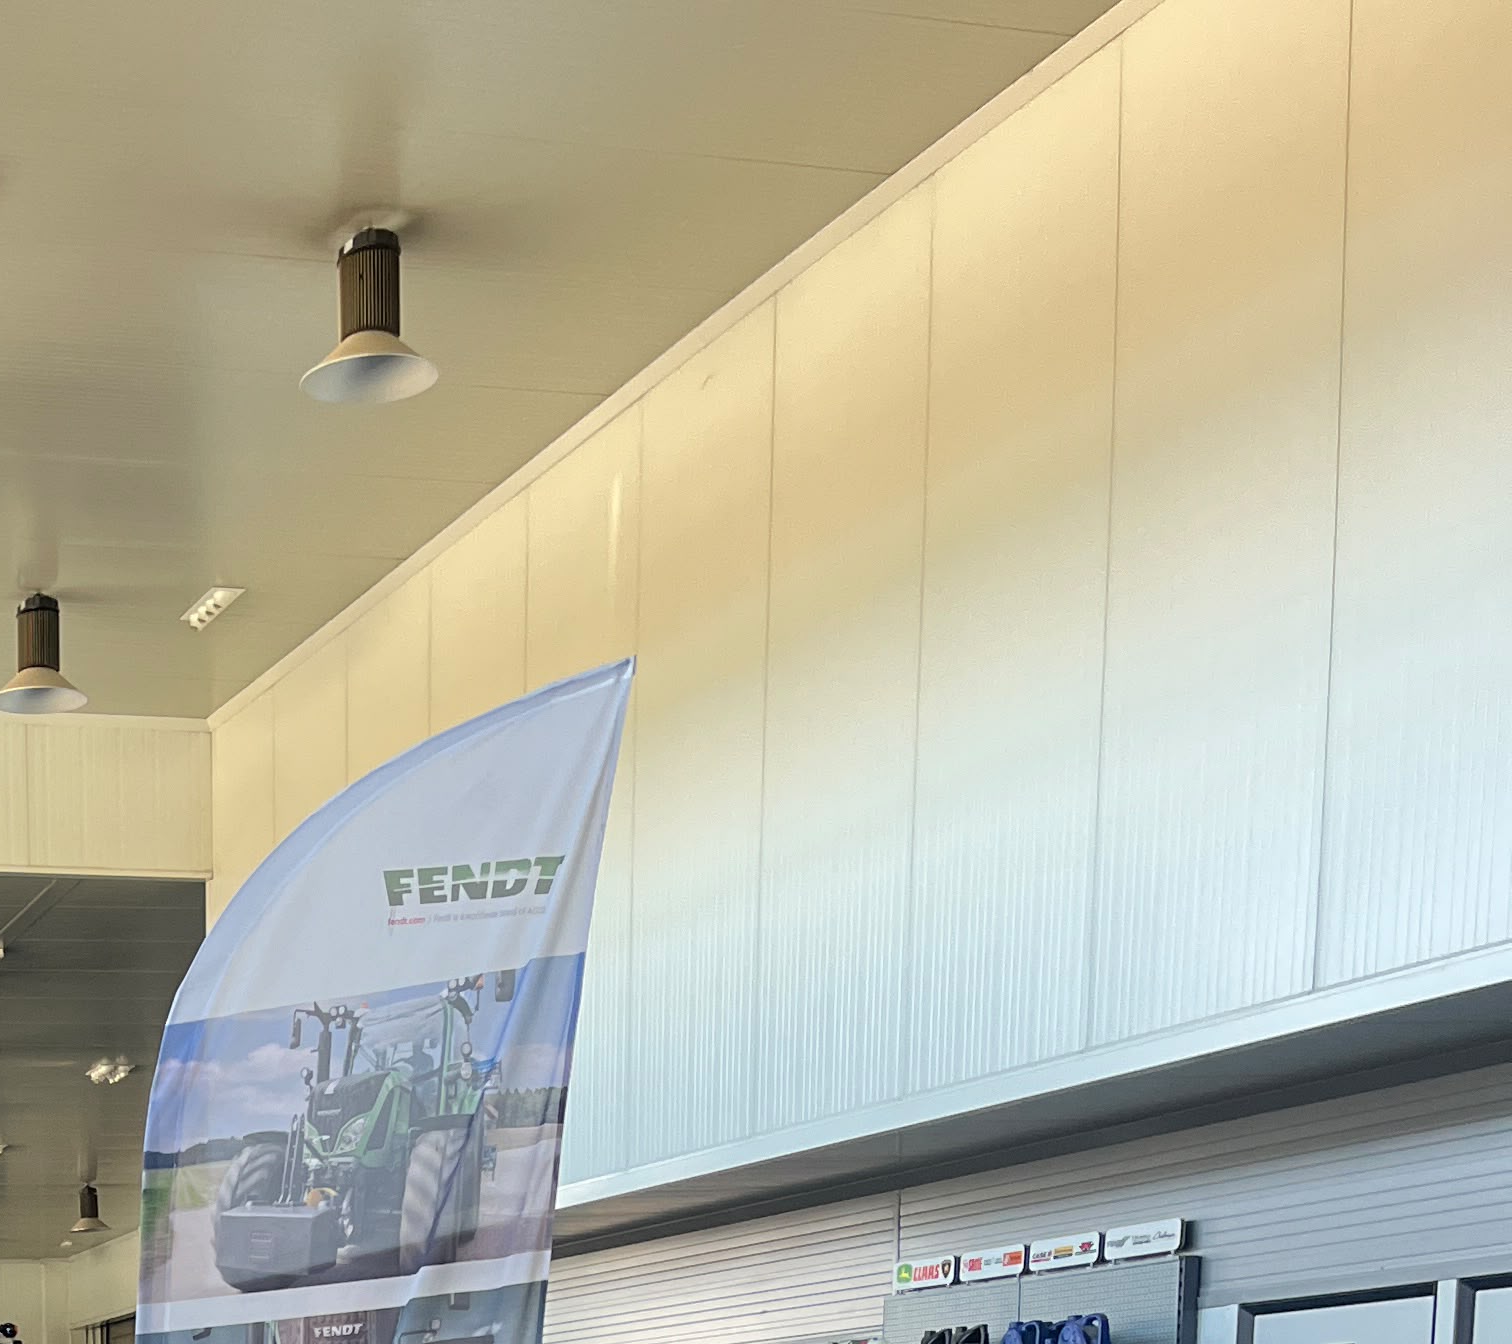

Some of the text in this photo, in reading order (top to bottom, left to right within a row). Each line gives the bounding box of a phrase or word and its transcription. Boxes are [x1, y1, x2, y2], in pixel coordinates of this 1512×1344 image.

[383, 855, 565, 906] FENDT
[913, 1264, 940, 1282] CLAAS
[313, 1322, 364, 1338] FENDT
